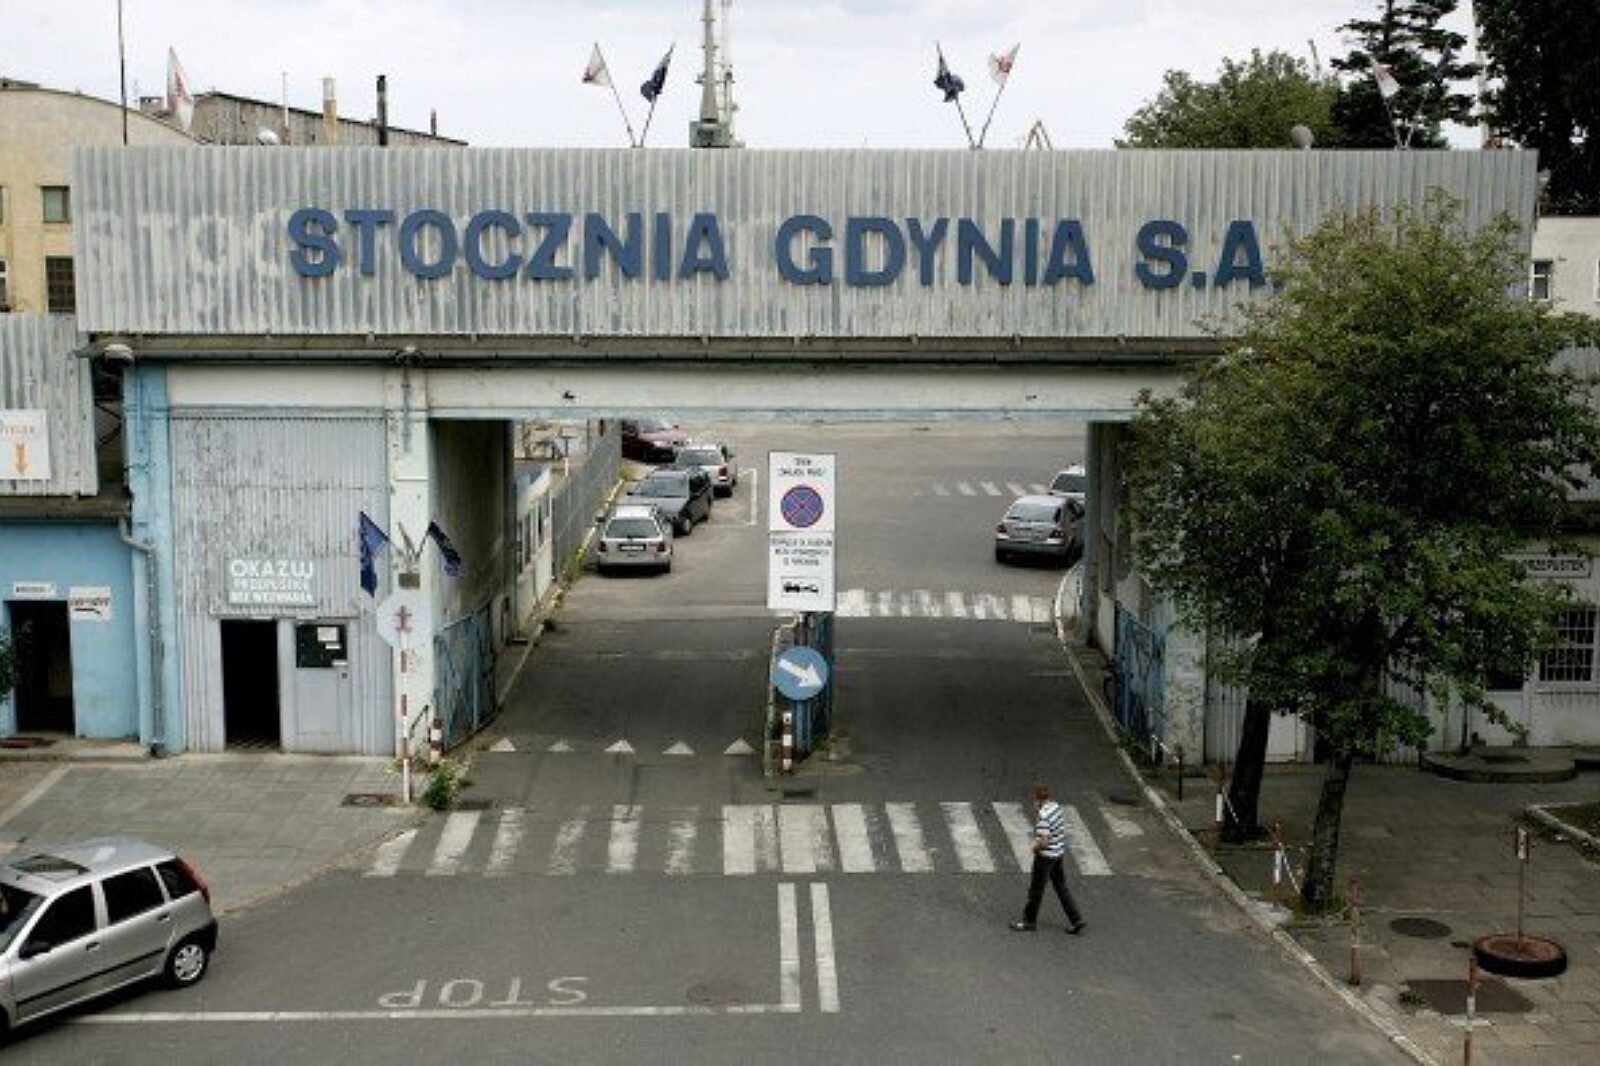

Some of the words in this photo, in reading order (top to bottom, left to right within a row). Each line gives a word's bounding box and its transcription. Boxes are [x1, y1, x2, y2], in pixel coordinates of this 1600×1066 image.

[288, 207, 730, 282] STOCZNIA
[775, 214, 1094, 287] GDYNIA
[231, 559, 314, 579] OKAZUJ
[378, 976, 588, 1008] STOP
